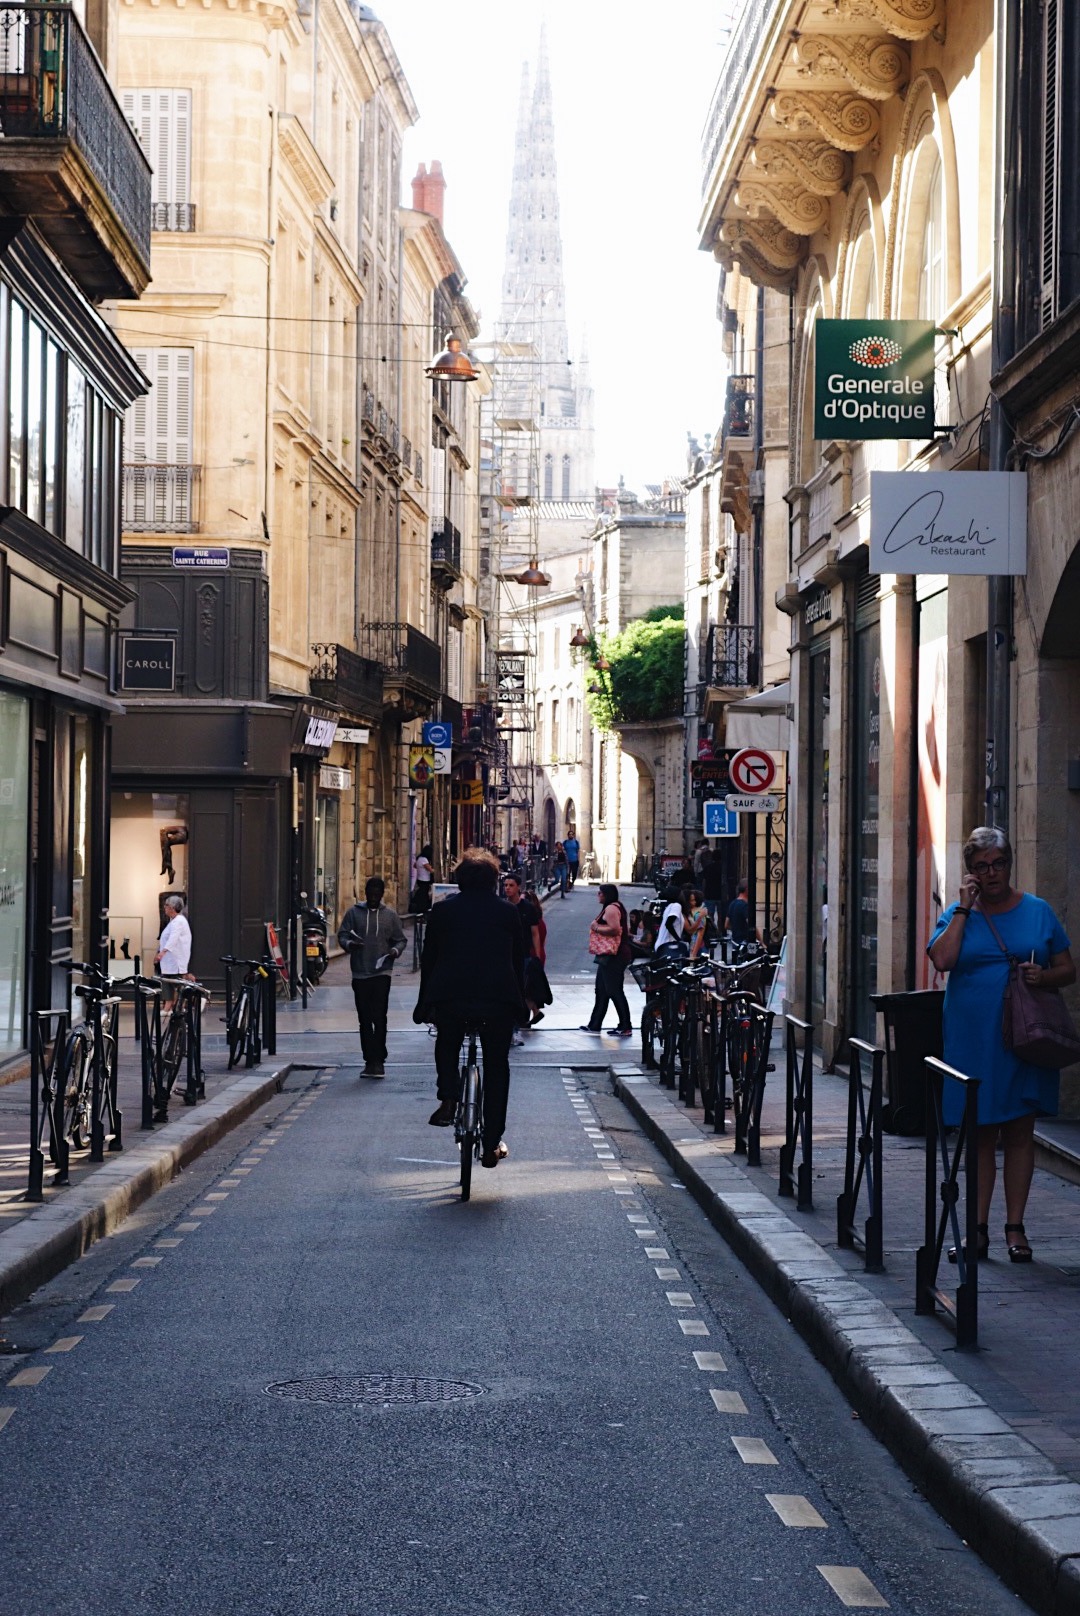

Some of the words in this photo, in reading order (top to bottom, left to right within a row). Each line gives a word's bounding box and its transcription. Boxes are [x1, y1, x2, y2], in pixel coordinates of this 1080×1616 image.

[827, 374, 924, 395] Generale
[823, 399, 926, 423] d'Optique
[930, 546, 986, 556] Restaurant
[175, 557, 195, 565] SAINTE
[196, 558, 227, 566] CATHERINE
[126, 660, 171, 669] CAROLL
